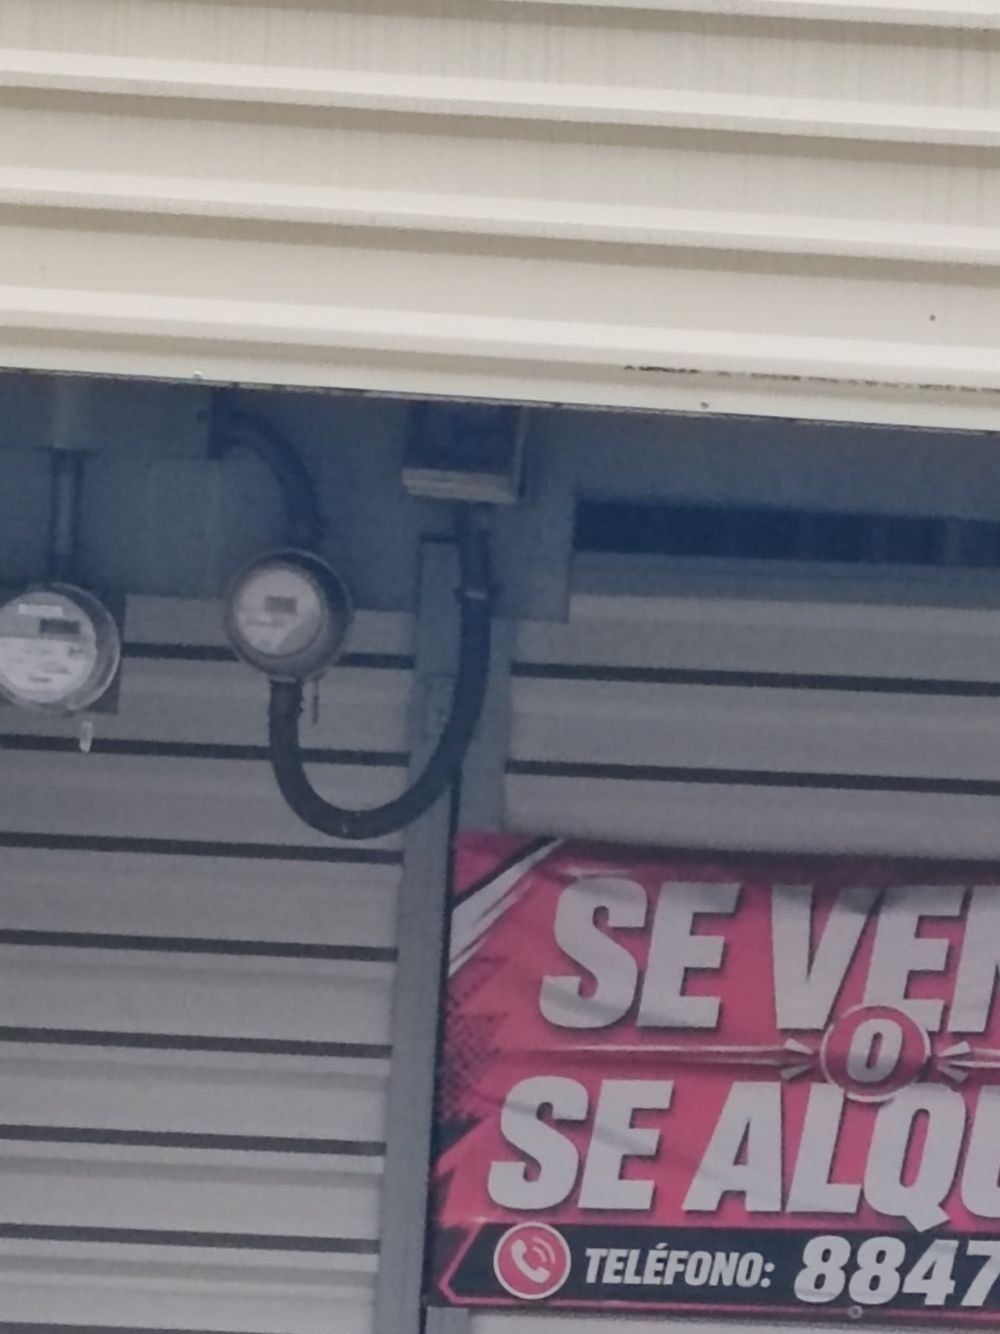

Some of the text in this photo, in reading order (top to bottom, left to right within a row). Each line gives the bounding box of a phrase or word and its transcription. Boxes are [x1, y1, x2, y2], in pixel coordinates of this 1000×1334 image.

[539, 877, 741, 1031] SE
[844, 1018, 904, 1084] O
[486, 1075, 671, 1211] SE
[583, 1241, 776, 1288] TELÉFONO:
